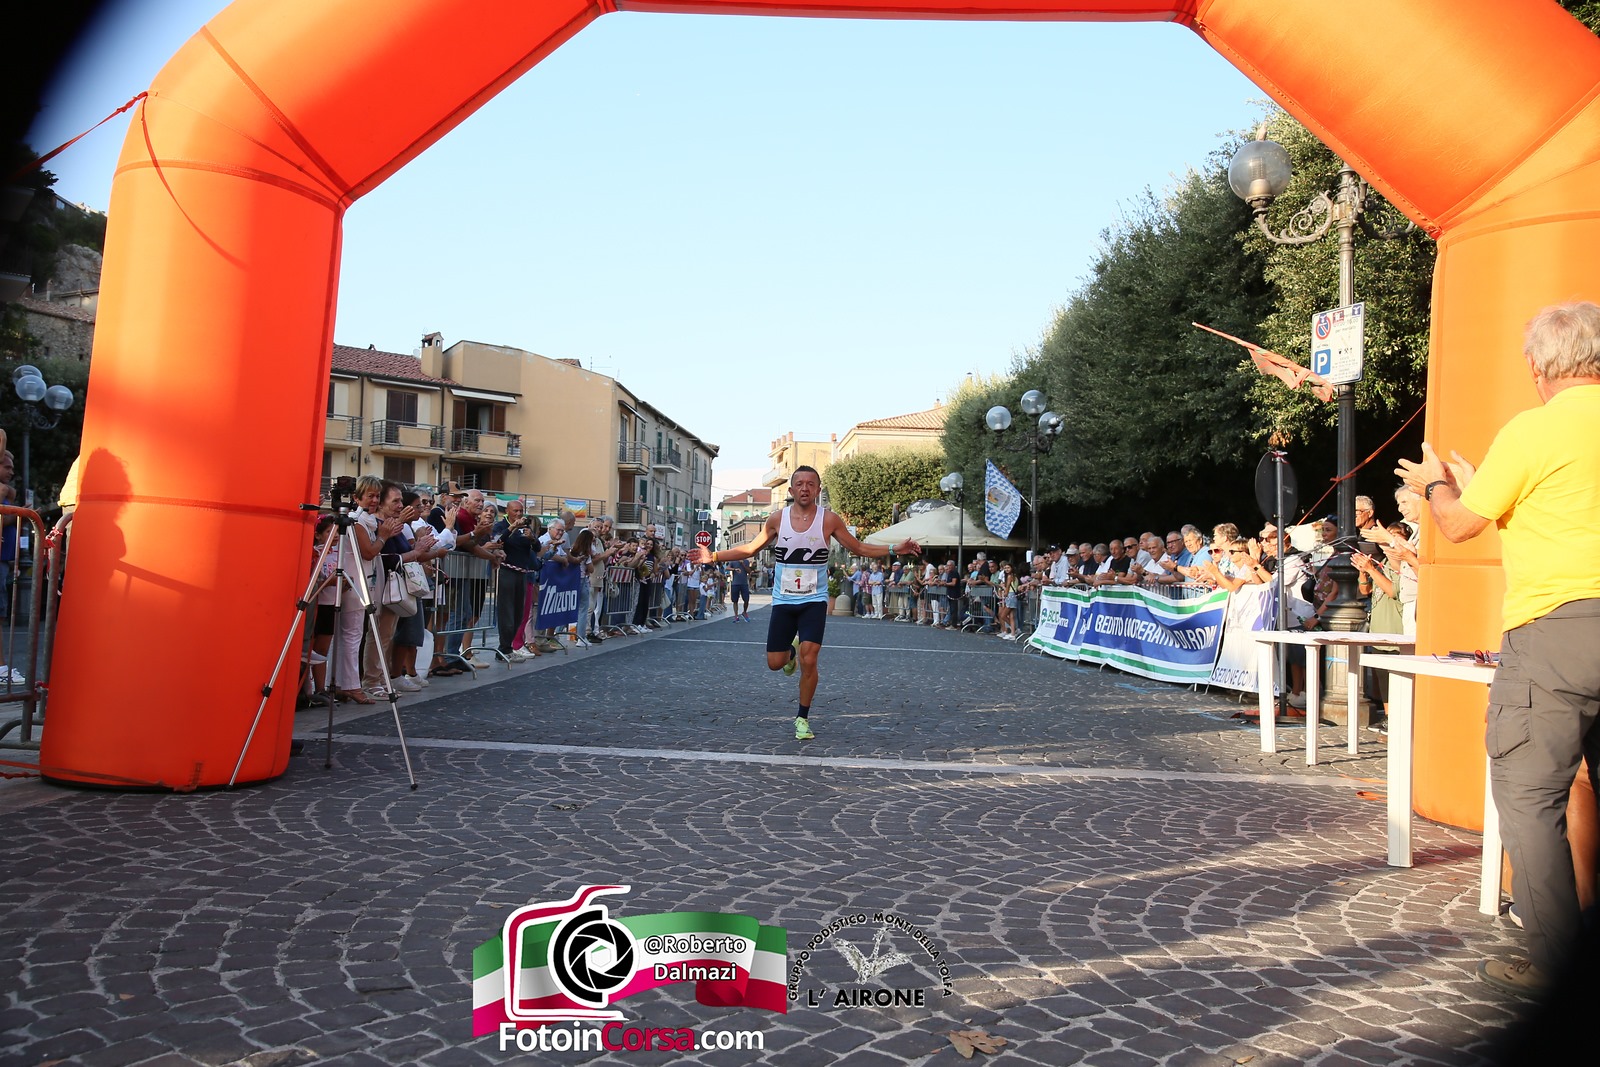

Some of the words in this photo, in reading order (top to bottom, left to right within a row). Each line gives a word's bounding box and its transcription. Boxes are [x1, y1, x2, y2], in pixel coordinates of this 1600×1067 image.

[1317, 353, 1328, 373] P
[795, 578, 801, 590] 1
[1211, 667, 1240, 686] SEZIONE
